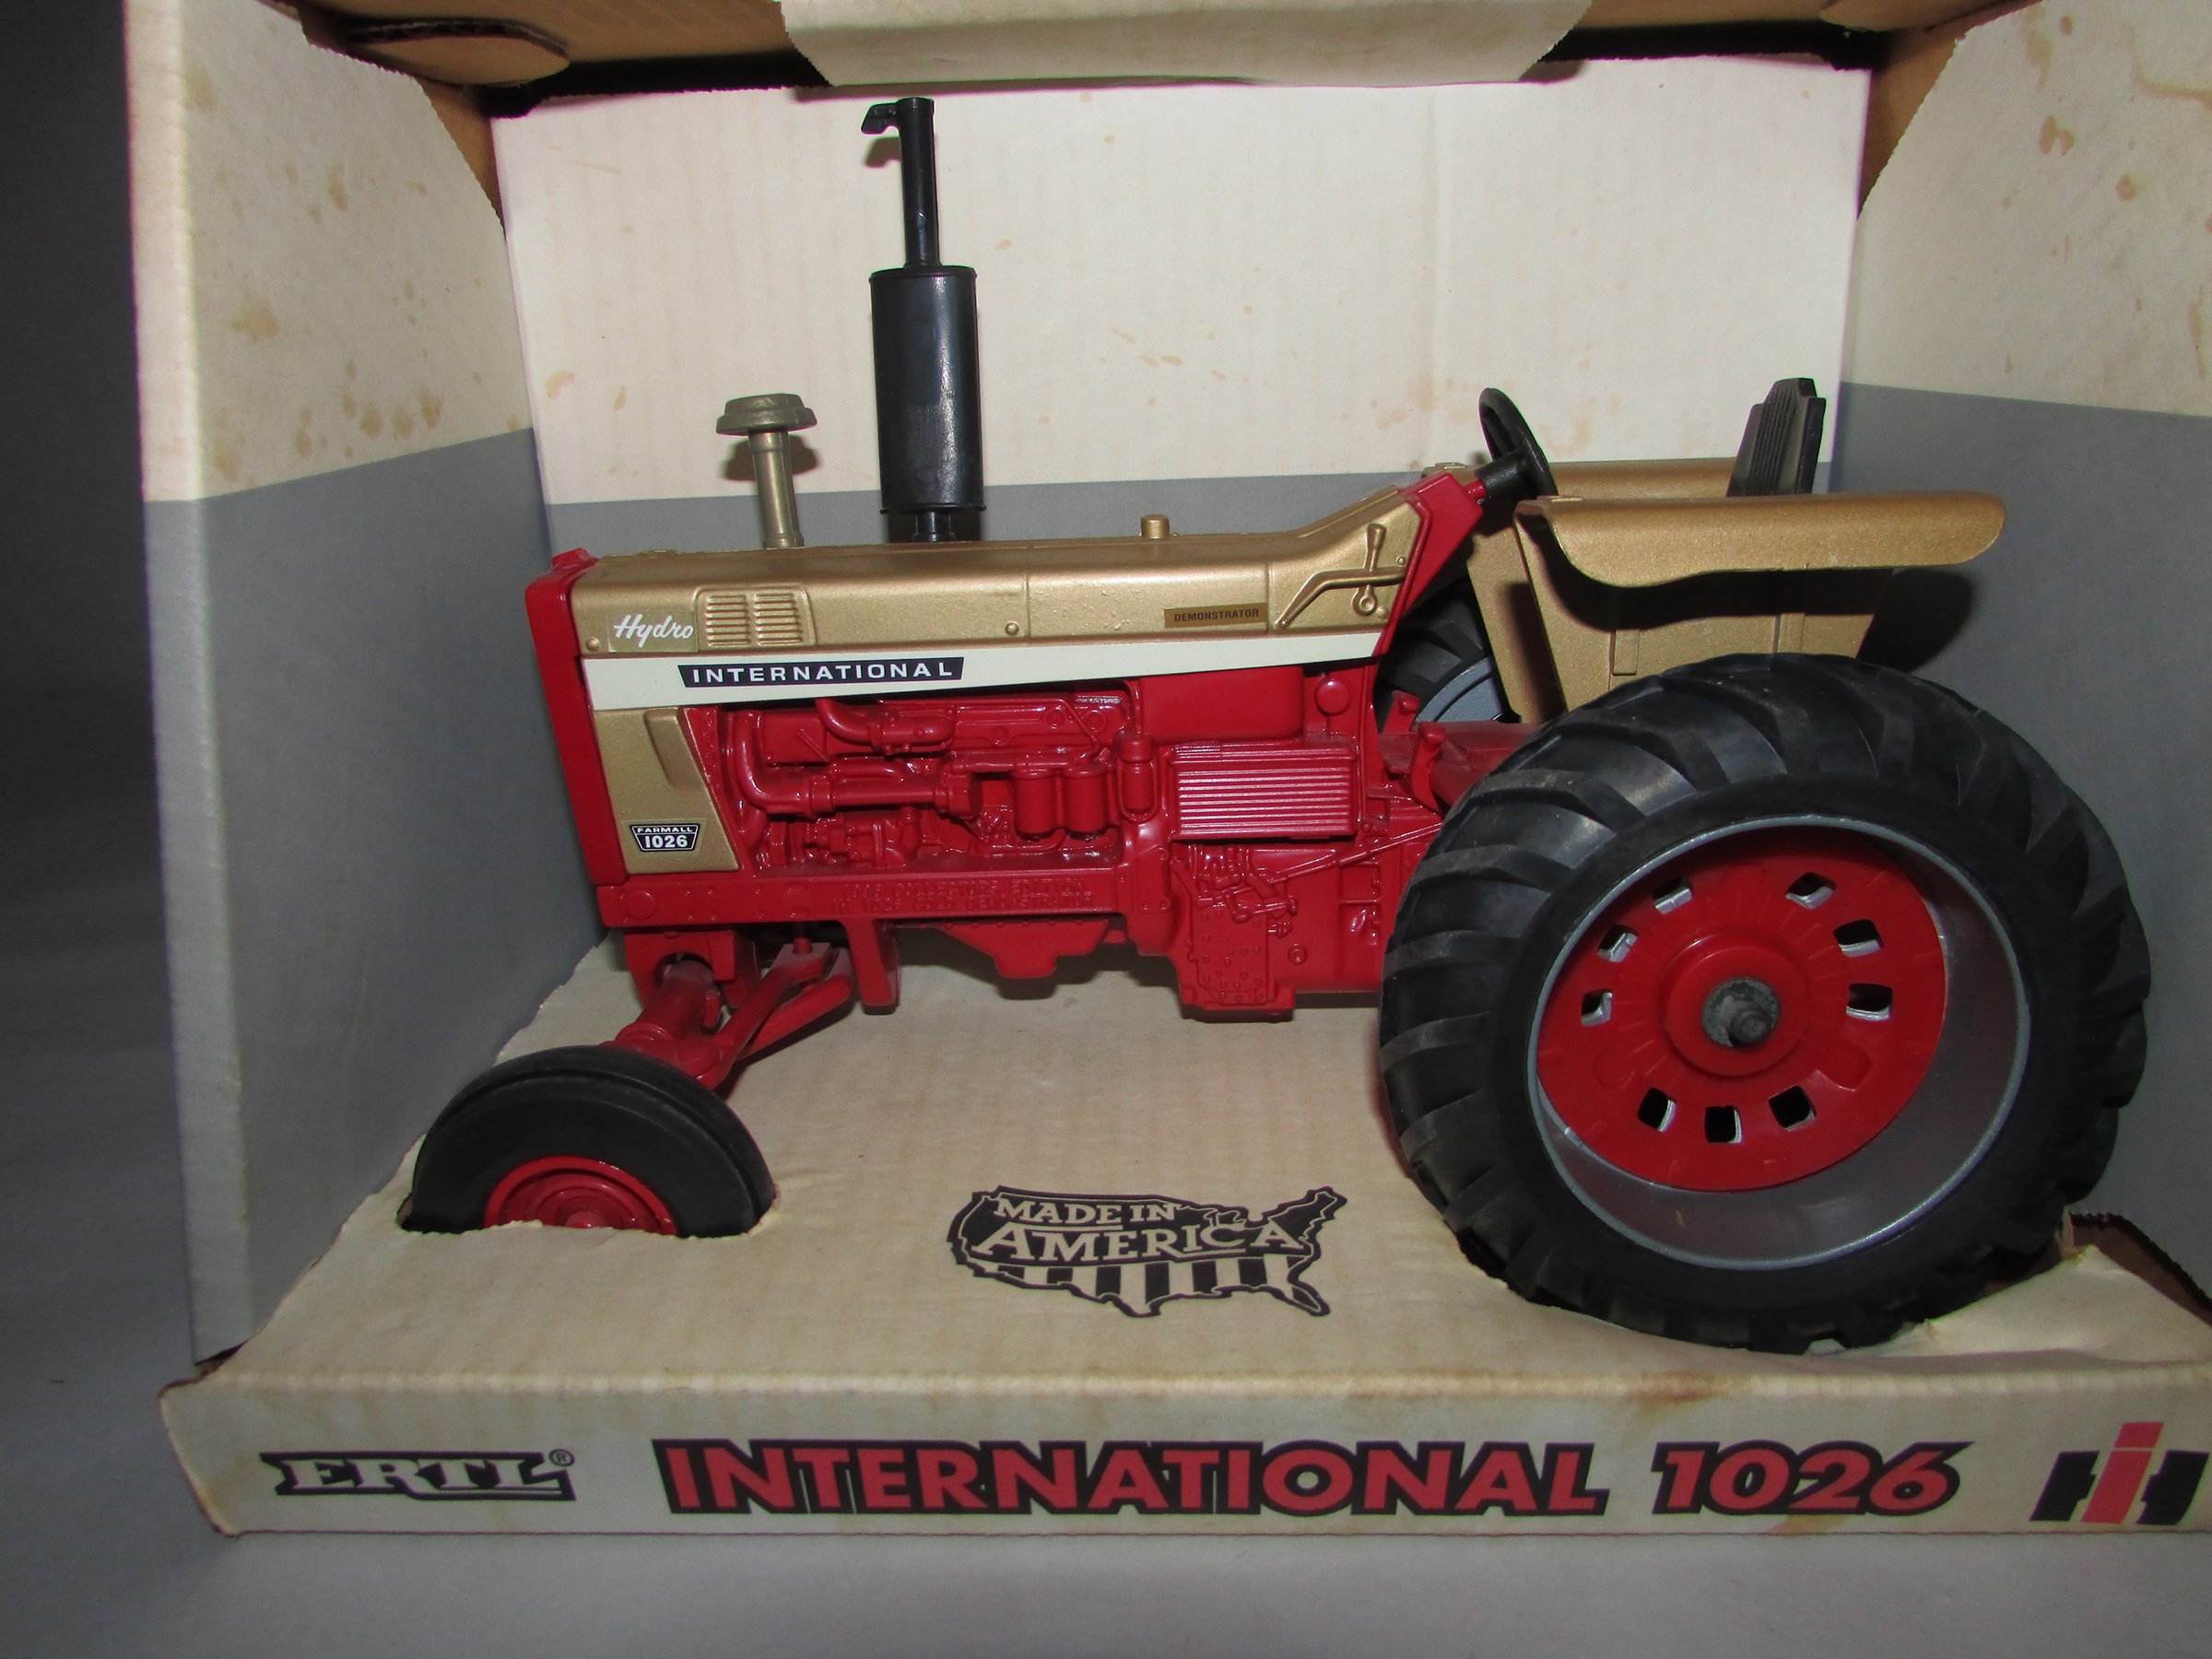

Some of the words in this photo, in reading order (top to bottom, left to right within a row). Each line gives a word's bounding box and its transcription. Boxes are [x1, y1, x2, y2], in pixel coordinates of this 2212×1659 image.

[1173, 608, 1260, 623] DEMONSTRATOR
[614, 615, 694, 648] Hydro
[693, 661, 955, 684] INTERNATIONAL
[637, 826, 693, 834] FARMALL
[645, 835, 688, 849] 1026
[994, 1198, 1123, 1225] MADE
[1130, 1201, 1181, 1223] IN
[971, 1218, 1306, 1263] AMERICA
[651, 1438, 1610, 1517] INTERNATIONAL
[1652, 1440, 1973, 1515] 1026
